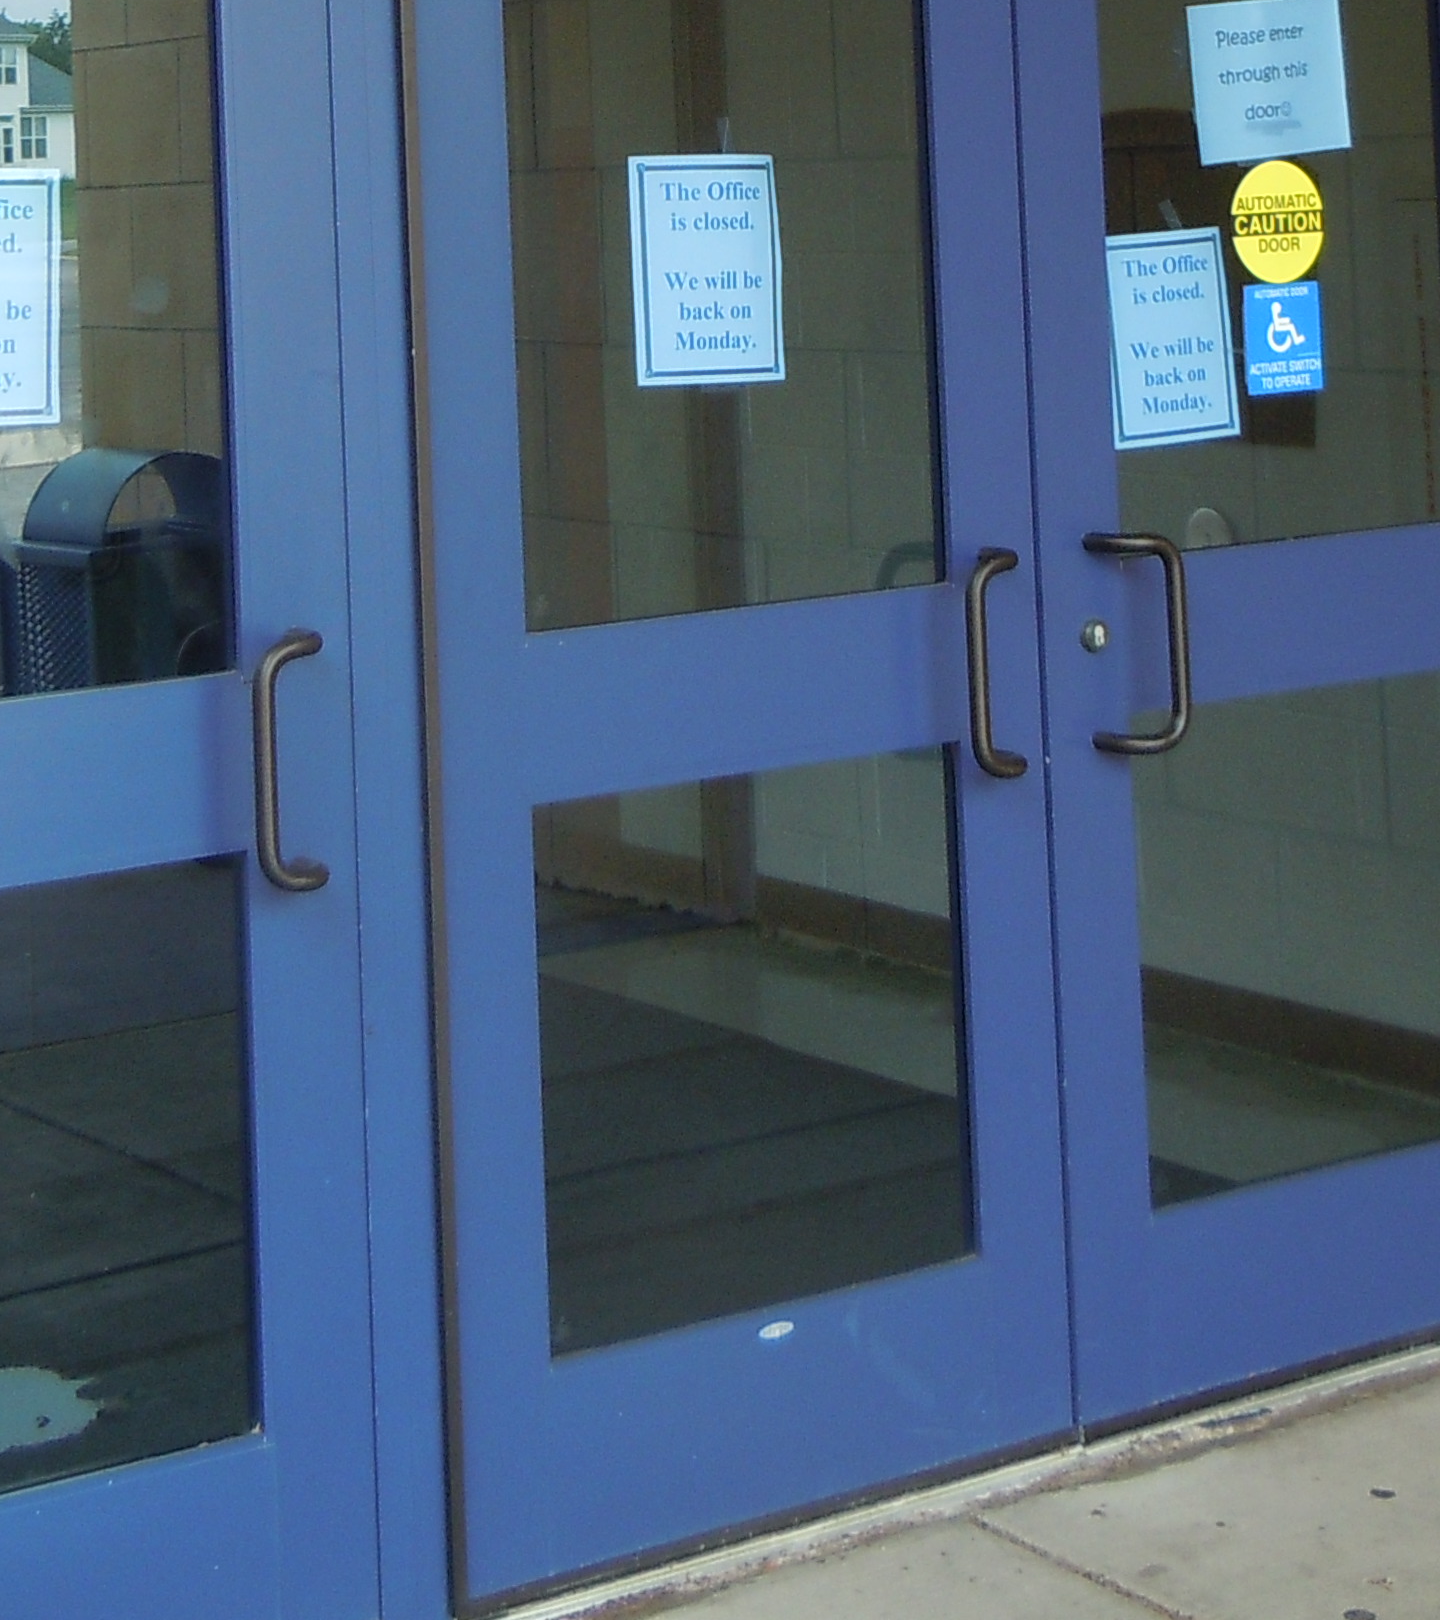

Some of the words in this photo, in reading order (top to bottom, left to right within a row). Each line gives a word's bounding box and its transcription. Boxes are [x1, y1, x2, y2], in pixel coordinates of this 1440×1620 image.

[1215, 28, 1266, 49] Please
[1269, 25, 1304, 42] enter
[1218, 64, 1281, 85] through
[1284, 60, 1308, 78] this
[660, 182, 700, 201] The
[707, 181, 760, 201] Office
[1236, 192, 1317, 212] AUTOMATIC
[671, 213, 687, 231] is
[693, 211, 754, 230] closed.
[1234, 212, 1321, 235] CAUTION
[1258, 236, 1300, 253] DOOR
[1121, 259, 1157, 278] The
[1162, 254, 1208, 275] Office
[664, 272, 698, 291] We
[705, 271, 737, 290] will
[743, 270, 762, 289] be
[1133, 288, 1147, 305] is
[1152, 281, 1205, 304] closed.
[6, 300, 32, 320] be
[679, 301, 724, 321] back
[730, 305, 751, 319] on
[675, 331, 756, 354] Monday.
[1129, 341, 1160, 360] We
[1164, 337, 1192, 357] will
[1196, 336, 1214, 353] be
[1144, 366, 1183, 387] back
[1187, 368, 1206, 383] on
[1249, 360, 1288, 376] ACTIVATE
[1288, 358, 1321, 373] SWITCH
[1261, 376, 1274, 389] TO
[1274, 373, 1311, 388] OPERATE
[1142, 393, 1212, 415] Monday.
